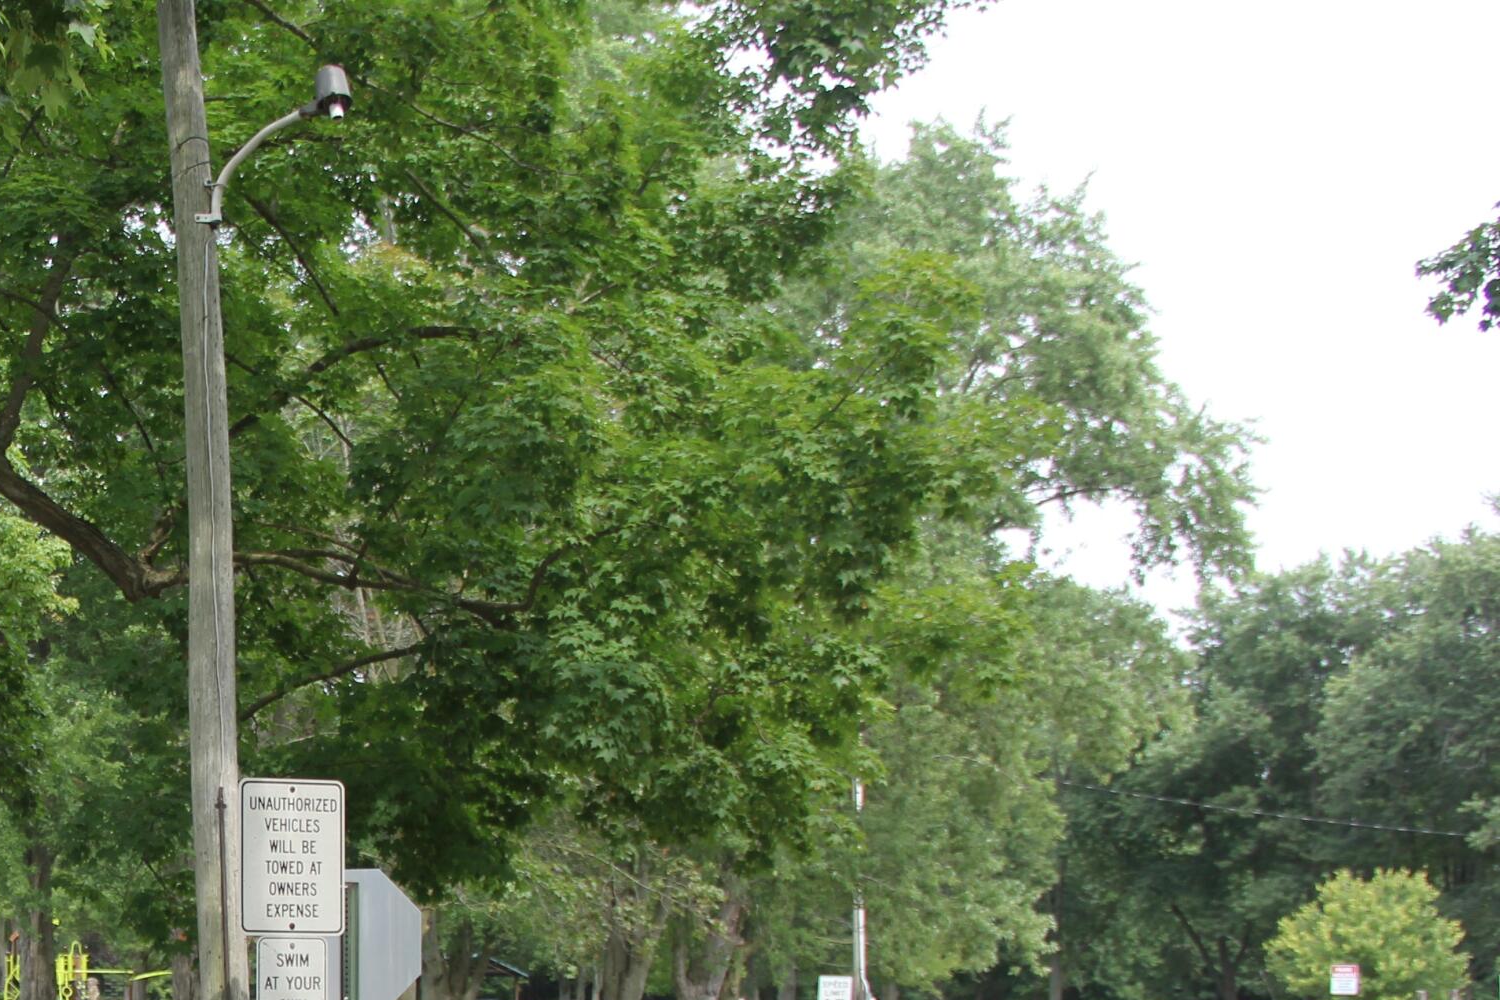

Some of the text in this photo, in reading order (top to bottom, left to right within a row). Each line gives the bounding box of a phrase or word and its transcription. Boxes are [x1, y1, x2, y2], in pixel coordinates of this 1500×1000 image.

[249, 796, 338, 813] UNAUTHORIZED
[264, 818, 321, 833] VEHICLES
[269, 839, 317, 854] WILL BE
[266, 860, 322, 875] TOWED AT
[269, 881, 317, 896] OWNERS
[266, 903, 319, 918] EXPENSE
[276, 953, 309, 968] SWIM
[264, 976, 321, 990] AT YOUR
